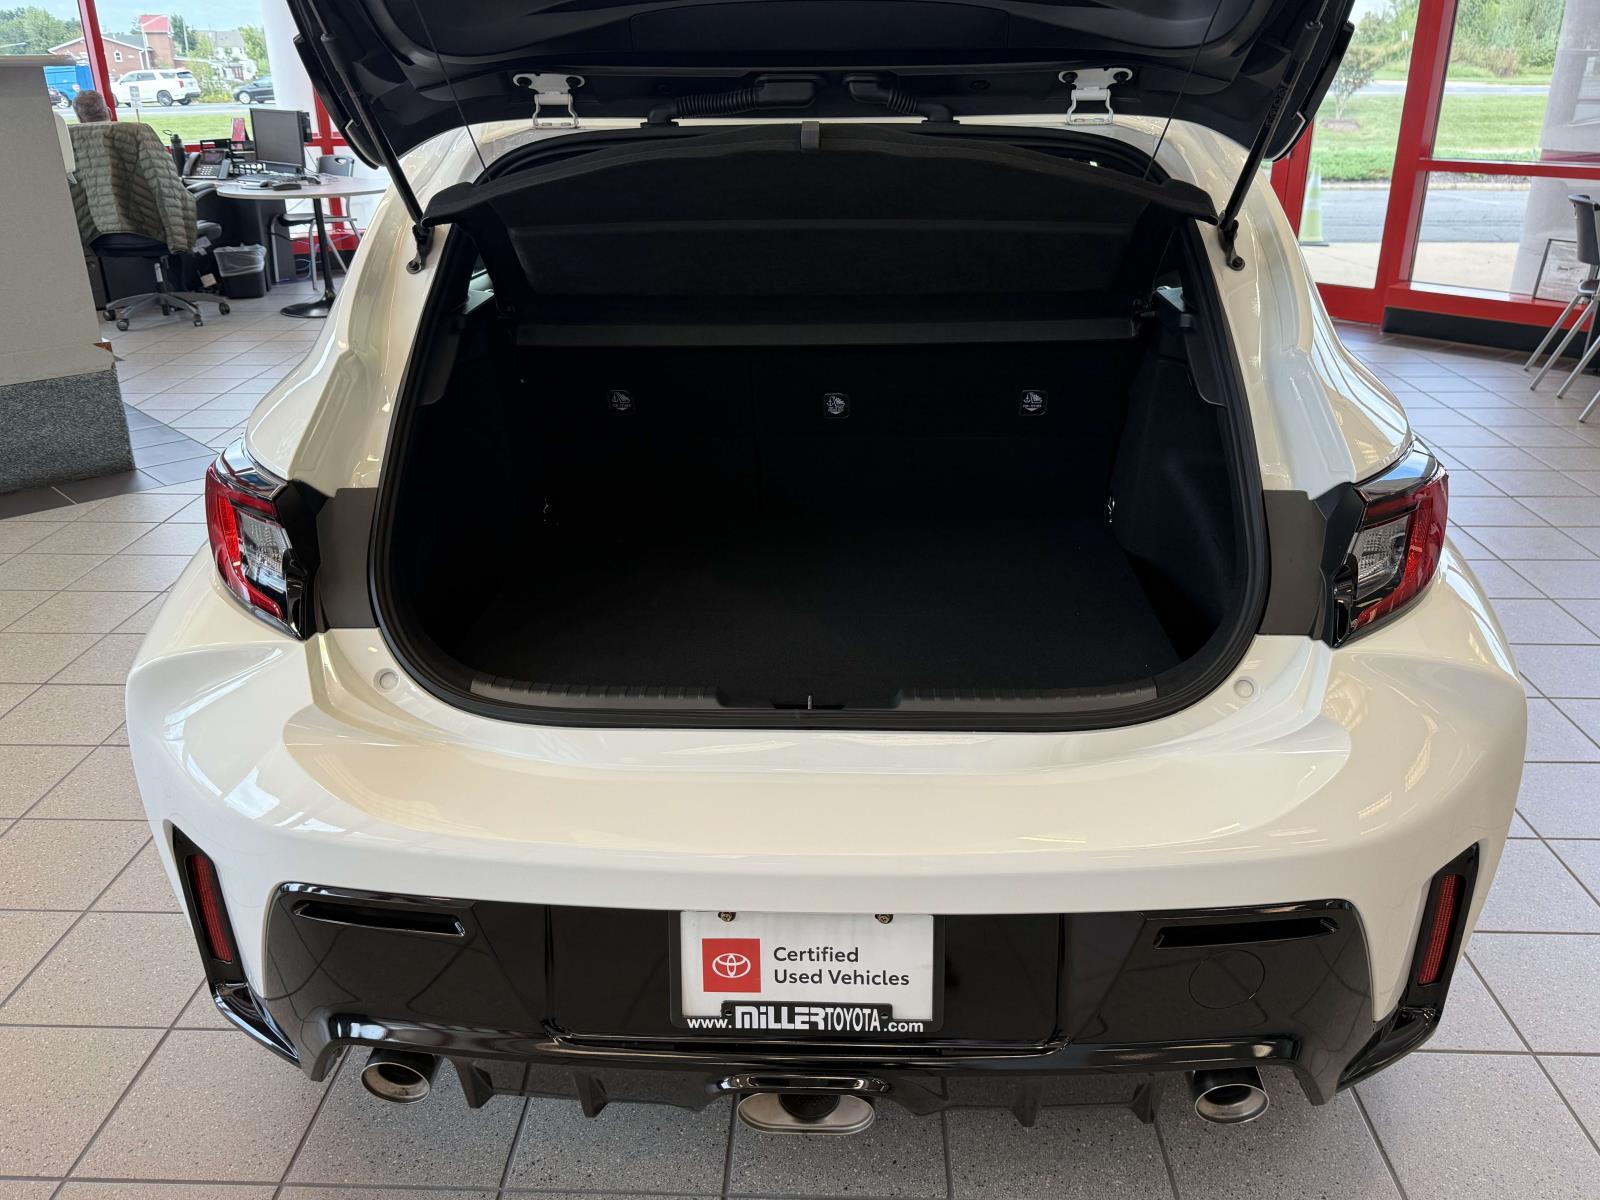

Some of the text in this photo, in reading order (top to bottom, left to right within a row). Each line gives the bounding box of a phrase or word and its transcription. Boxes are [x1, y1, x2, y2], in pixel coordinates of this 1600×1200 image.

[773, 946, 859, 962] Certified
[774, 969, 910, 986] Used Vehicles
